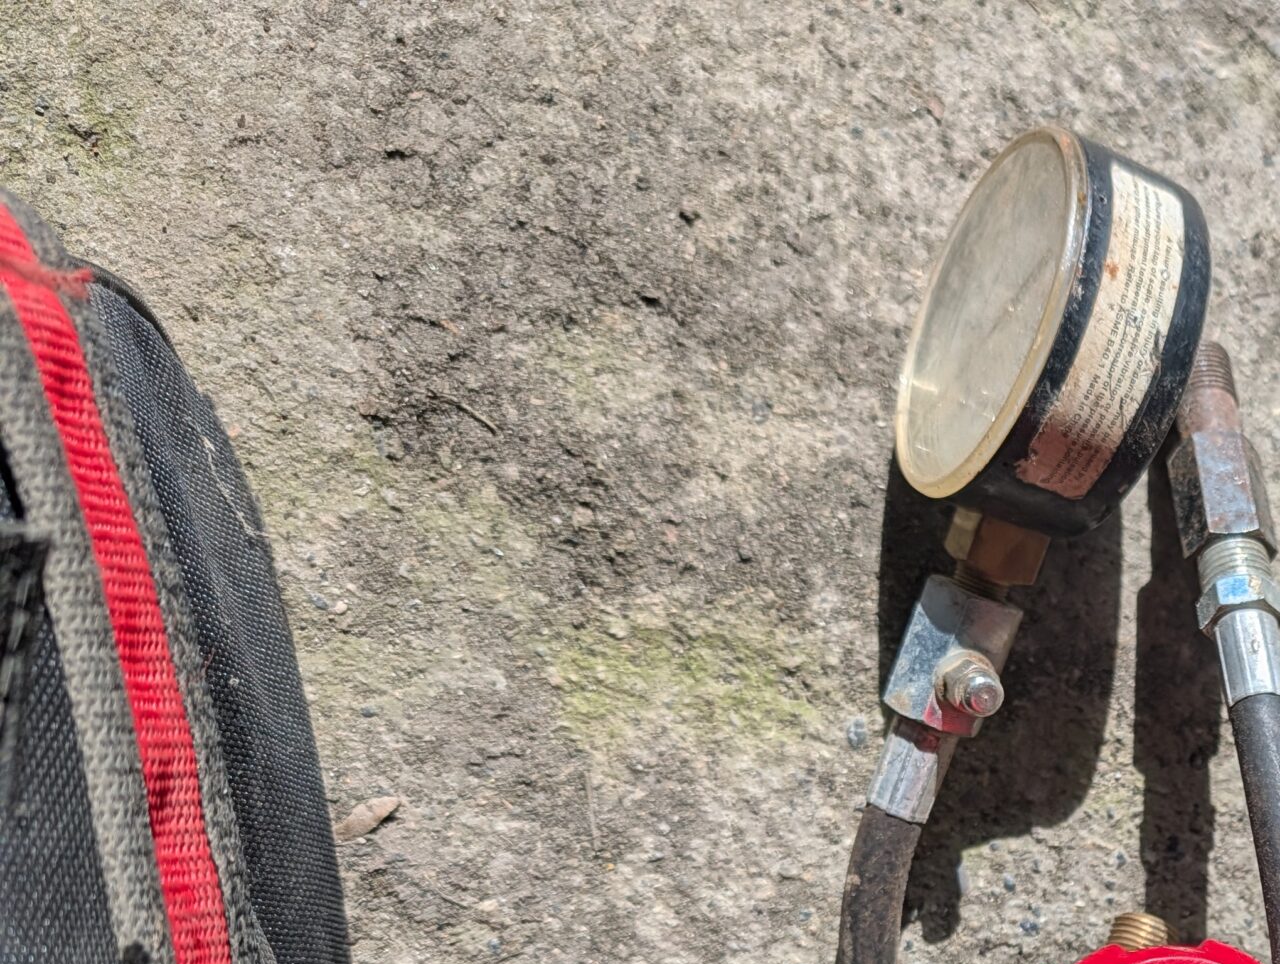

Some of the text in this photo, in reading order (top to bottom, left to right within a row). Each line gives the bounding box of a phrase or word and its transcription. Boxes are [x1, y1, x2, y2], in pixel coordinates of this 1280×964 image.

[1121, 262, 1137, 293] Refer
[1149, 266, 1158, 277] of
[1119, 292, 1130, 304] to
[1109, 304, 1128, 338] ASME
[1138, 329, 1155, 359] injury
[1135, 359, 1145, 370] or
[1082, 373, 1102, 402] Made
[1100, 379, 1112, 393] of
[1108, 357, 1134, 403] vibration
[1077, 400, 1088, 412] in
[1105, 409, 1121, 431] may
[1099, 430, 1111, 444] be
